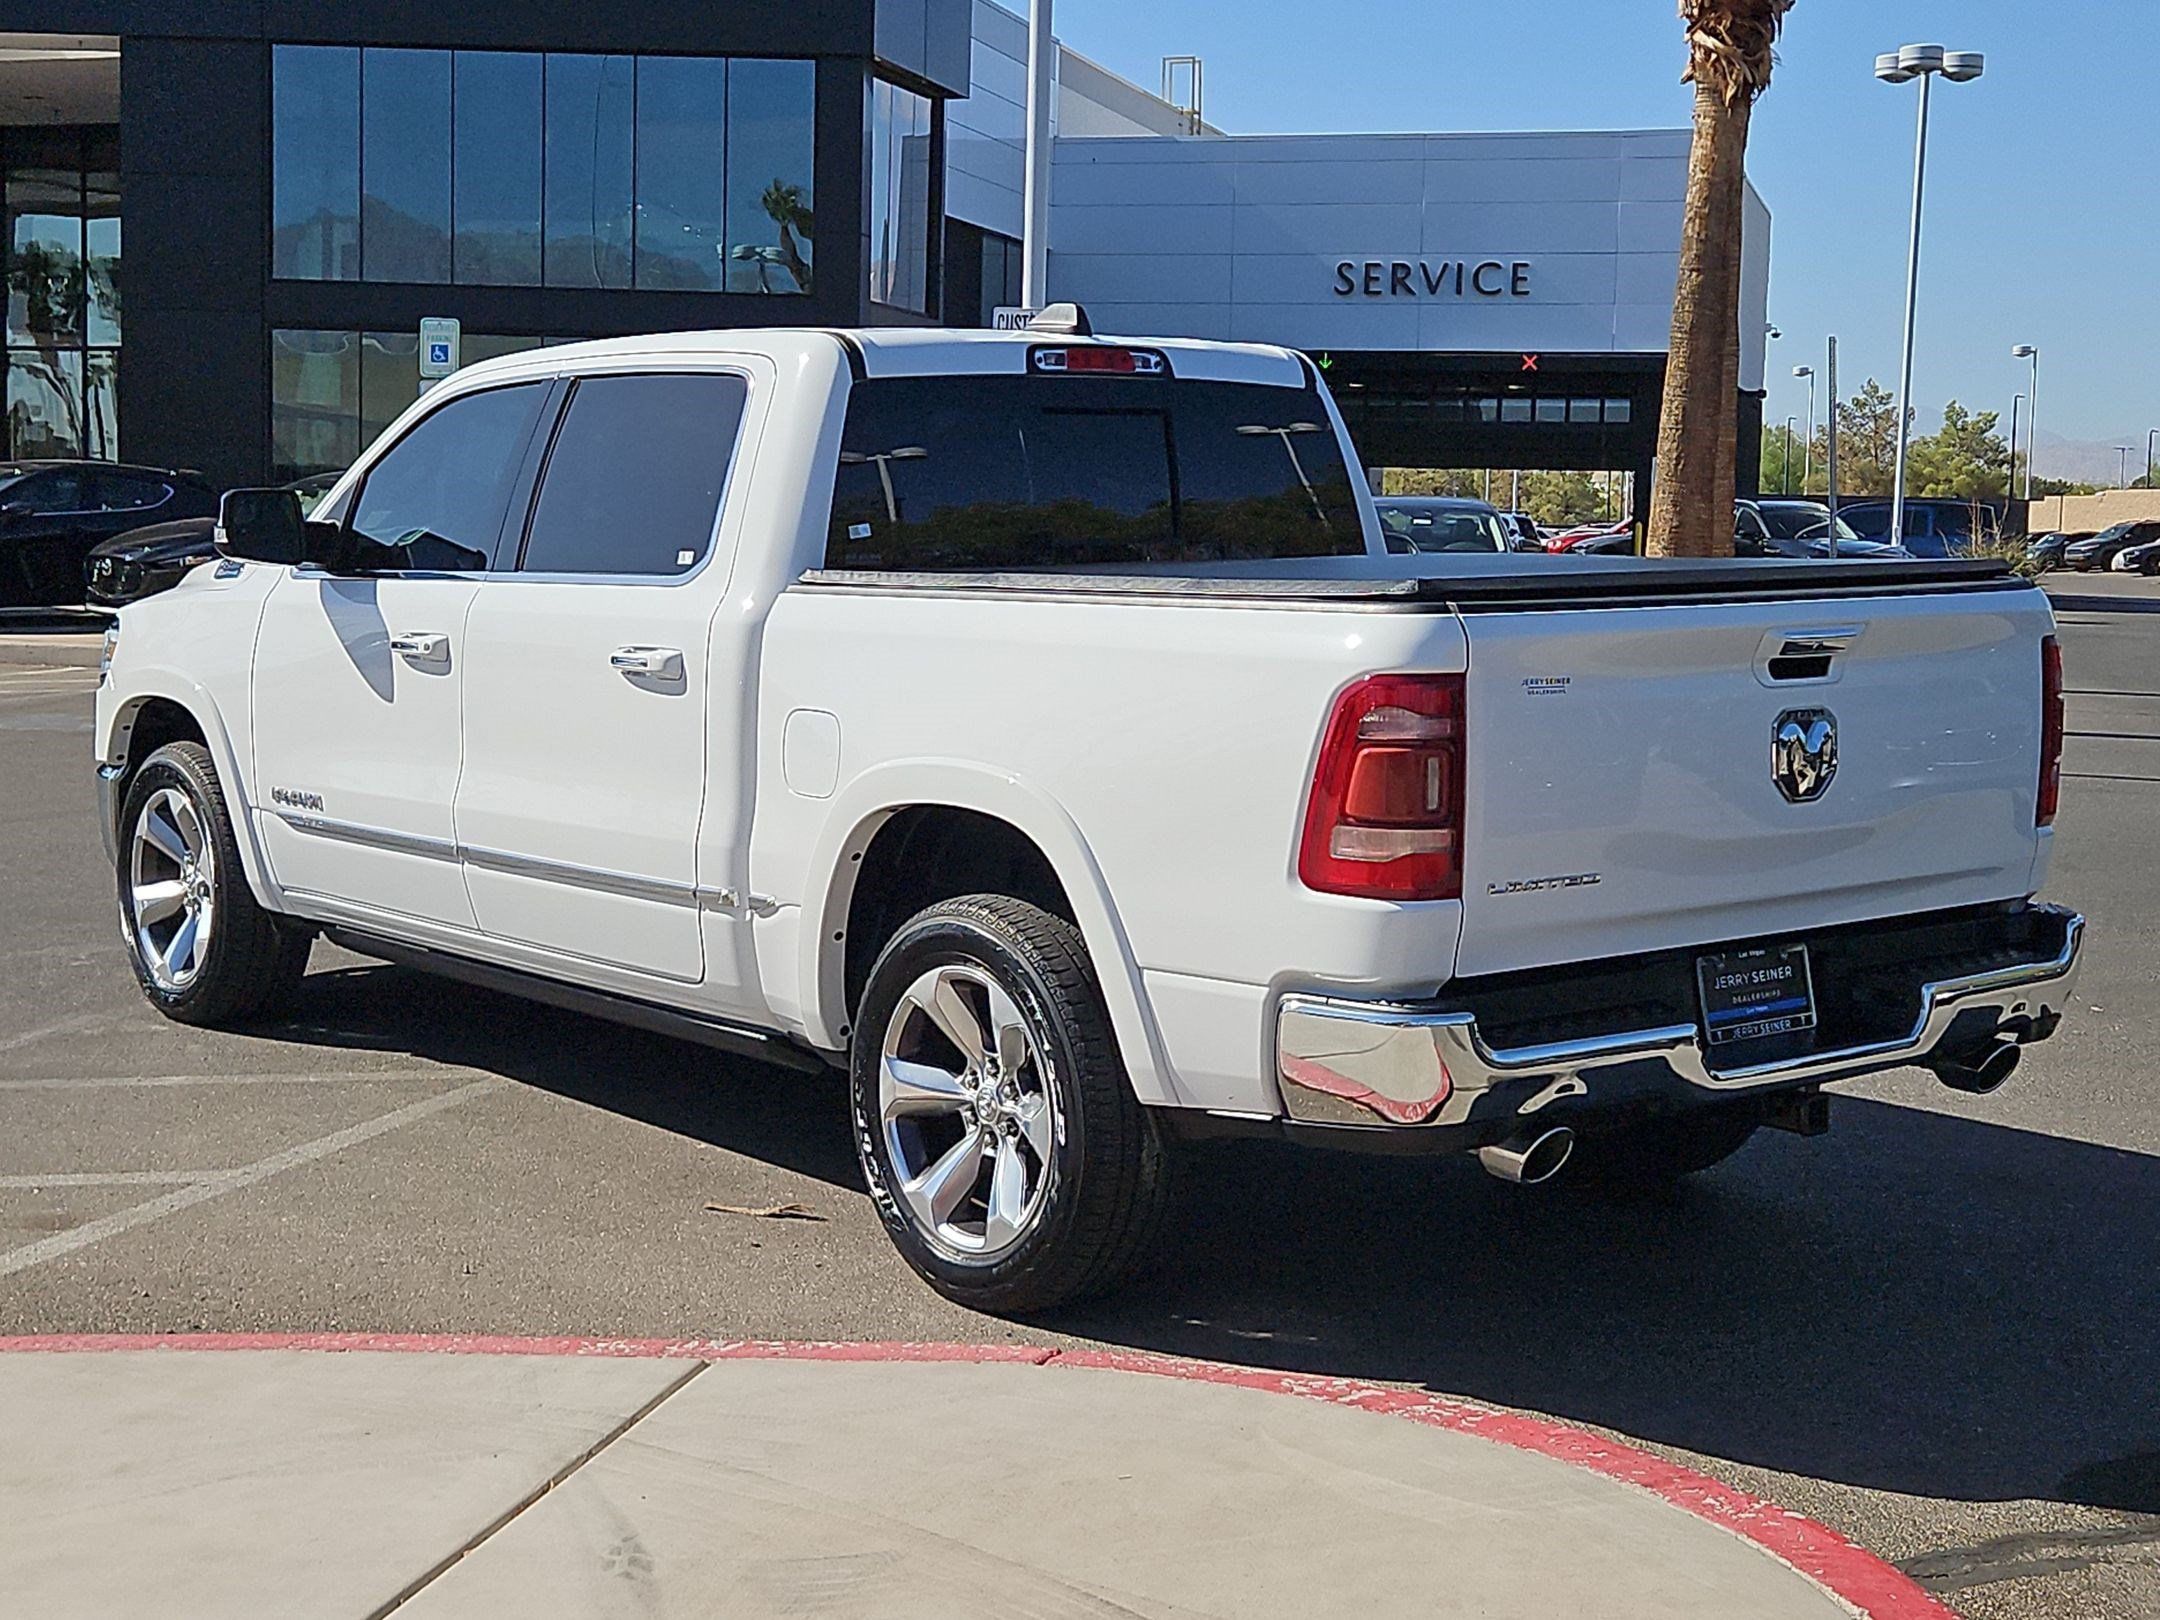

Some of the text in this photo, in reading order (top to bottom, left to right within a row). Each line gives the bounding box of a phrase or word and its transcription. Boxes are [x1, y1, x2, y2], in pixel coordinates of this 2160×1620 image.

[1333, 261, 1531, 297] SERVICE
[1487, 872, 1601, 895] LIMITED
[1714, 965, 1793, 990] JERRY SEINER
[1732, 1019, 1791, 1039] JERRY SEINER
